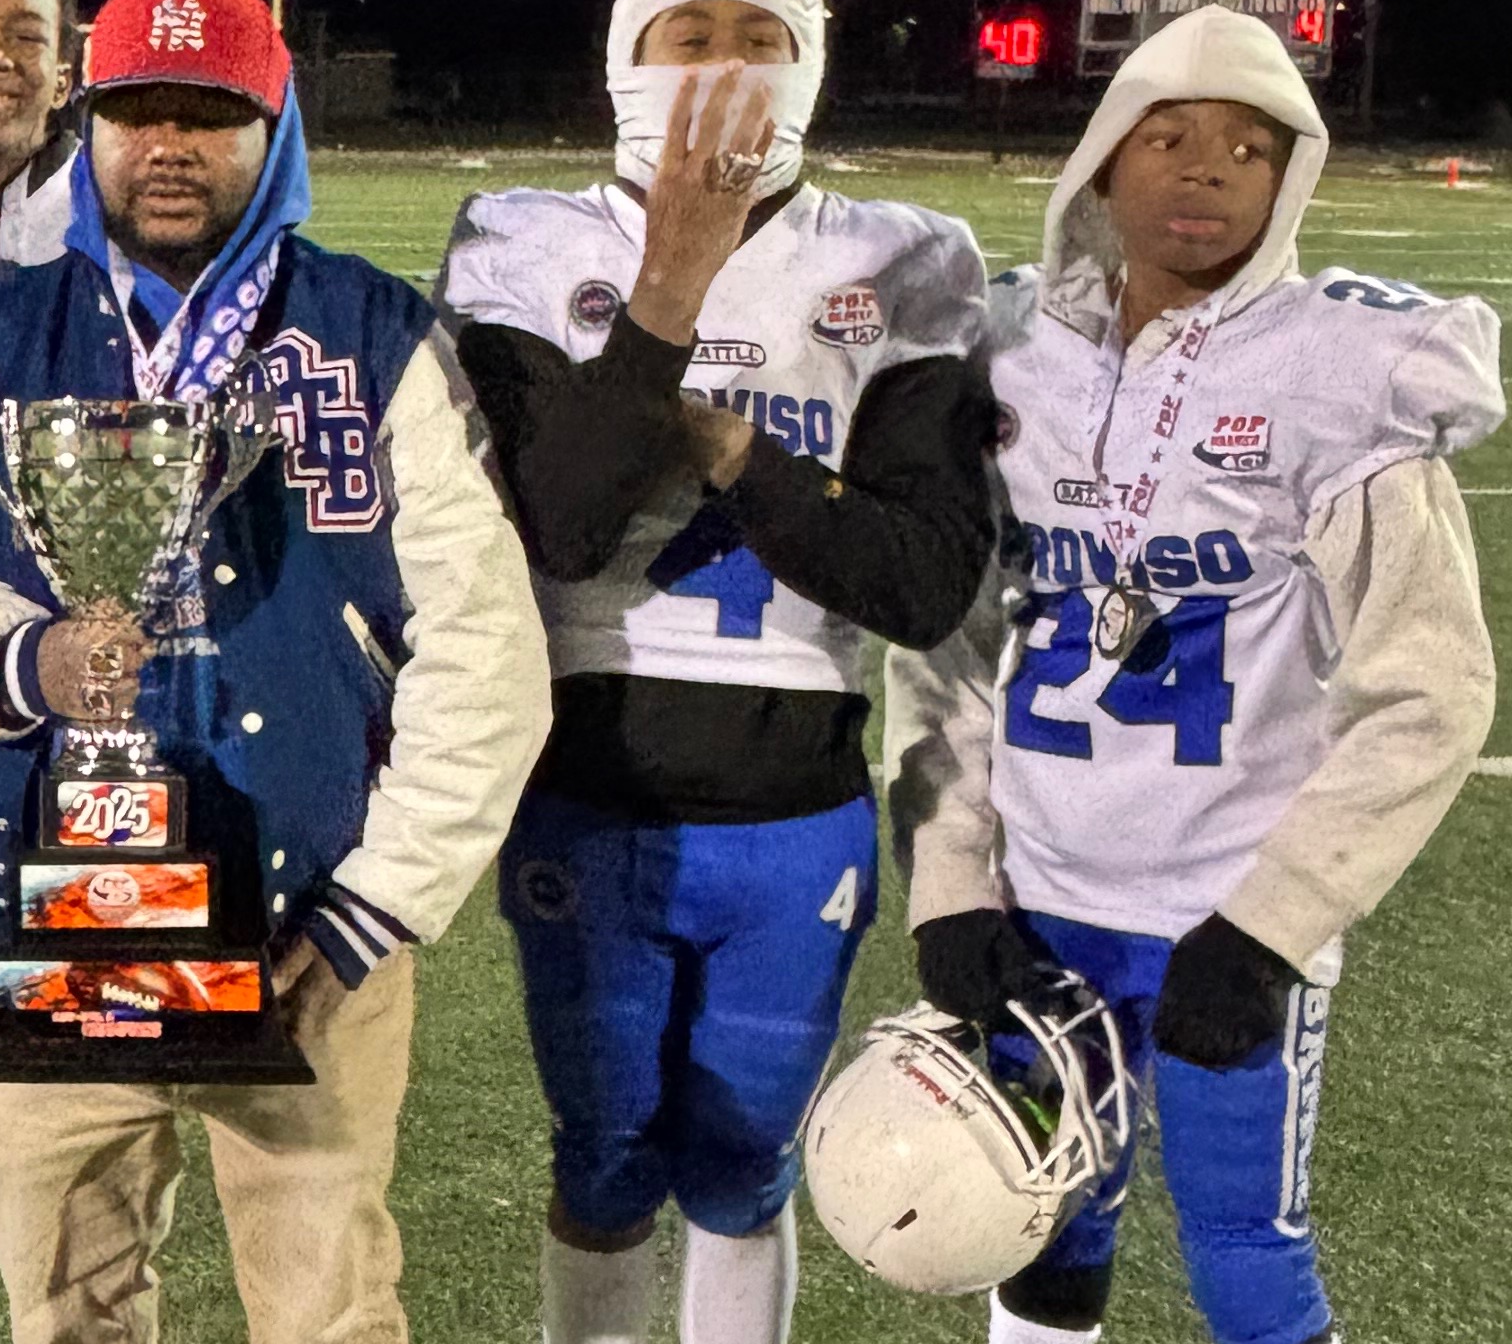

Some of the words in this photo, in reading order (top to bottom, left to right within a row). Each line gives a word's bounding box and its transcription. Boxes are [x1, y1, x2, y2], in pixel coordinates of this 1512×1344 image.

[980, 19, 1041, 65] 40
[1213, 416, 1267, 433] POP
[1021, 520, 1256, 590] ROVISO
[1005, 586, 1236, 767] 24
[70, 787, 151, 840] 2025
[818, 866, 858, 933] 4
